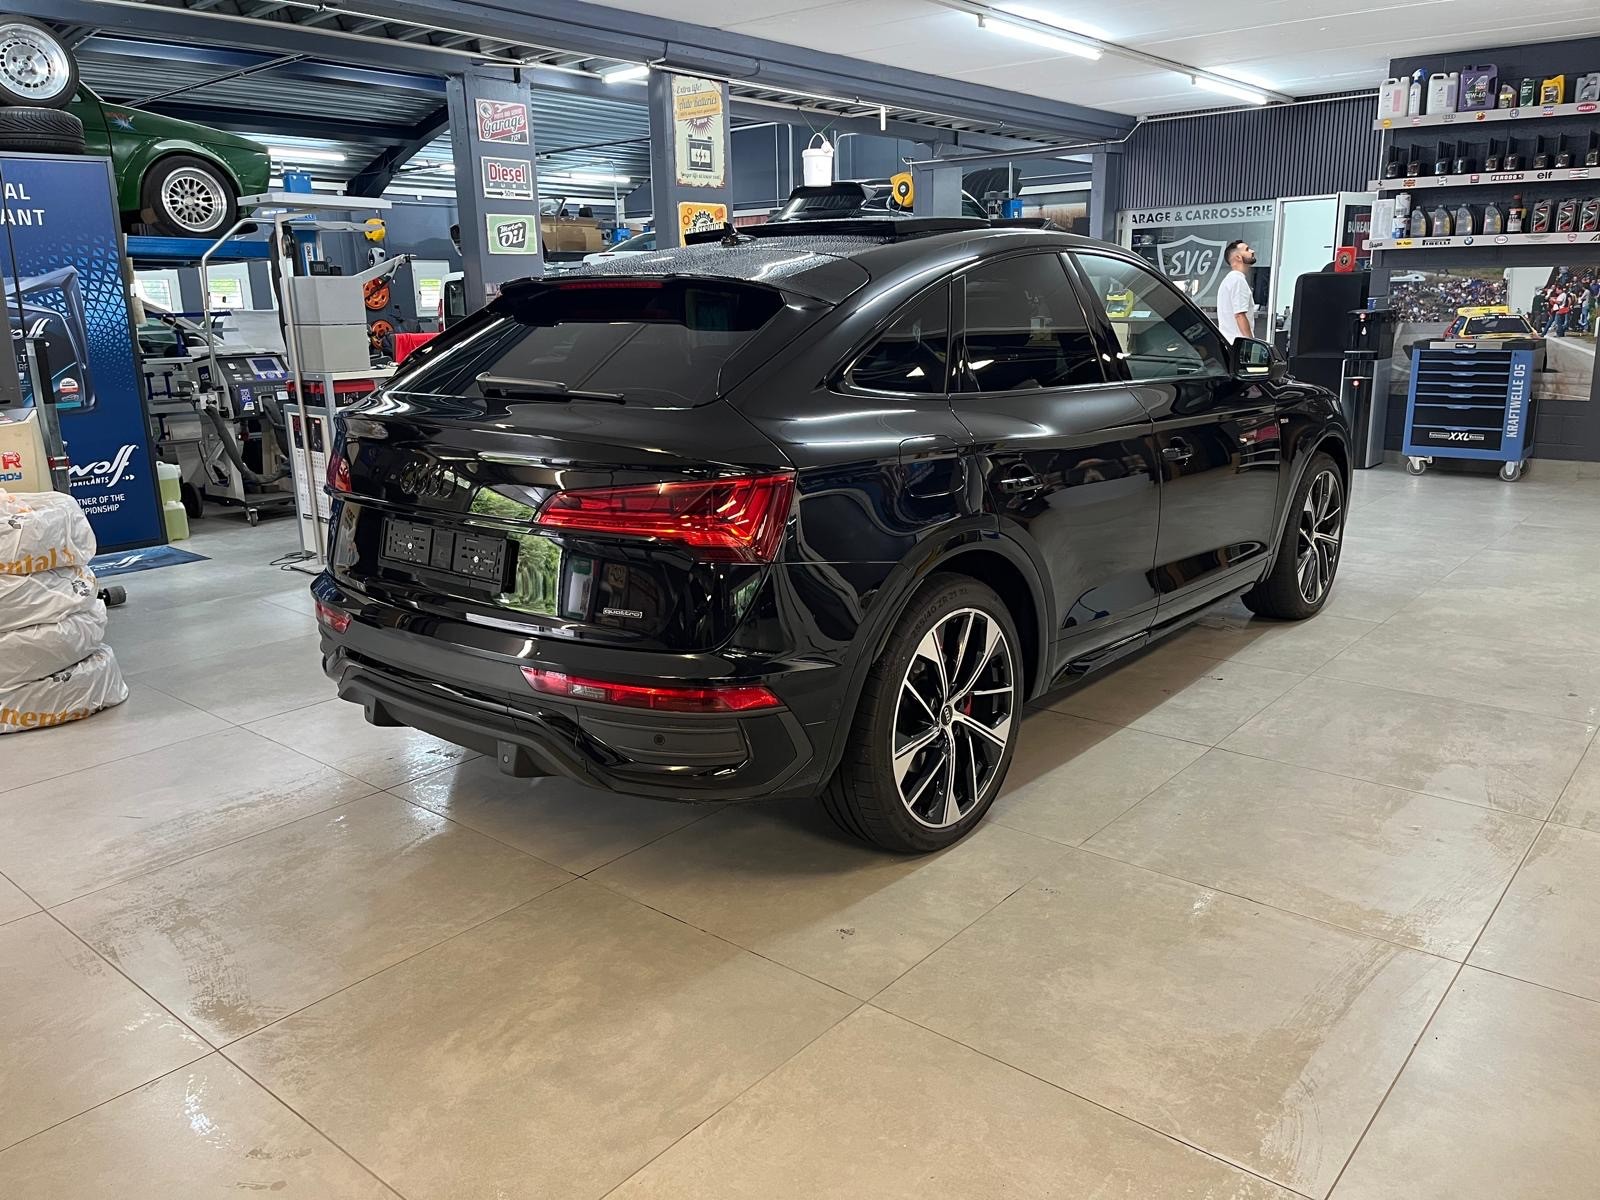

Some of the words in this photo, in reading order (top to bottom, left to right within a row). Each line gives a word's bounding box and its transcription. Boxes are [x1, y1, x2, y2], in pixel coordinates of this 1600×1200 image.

[488, 162, 527, 184] Diesel
[1537, 171, 1553, 180] elf
[5, 183, 31, 200] AL
[0, 208, 46, 226] ANT
[1131, 211, 1171, 224] ARAGE
[1174, 211, 1184, 222] &
[1185, 204, 1273, 221] CARROSSERIE
[500, 229, 525, 247] Oil
[1422, 238, 1452, 247] PIRELLI
[1169, 249, 1213, 276] SVG
[1513, 364, 1526, 377] 05
[1506, 379, 1524, 438] KRAFTWELLE
[1448, 432, 1470, 441] XXL
[69, 476, 110, 488] BRICANTS
[76, 497, 98, 506] TNER
[99, 495, 109, 504] OF
[110, 493, 126, 502] THE
[81, 503, 120, 515] PIONSHIP
[603, 608, 643, 618] quattro
